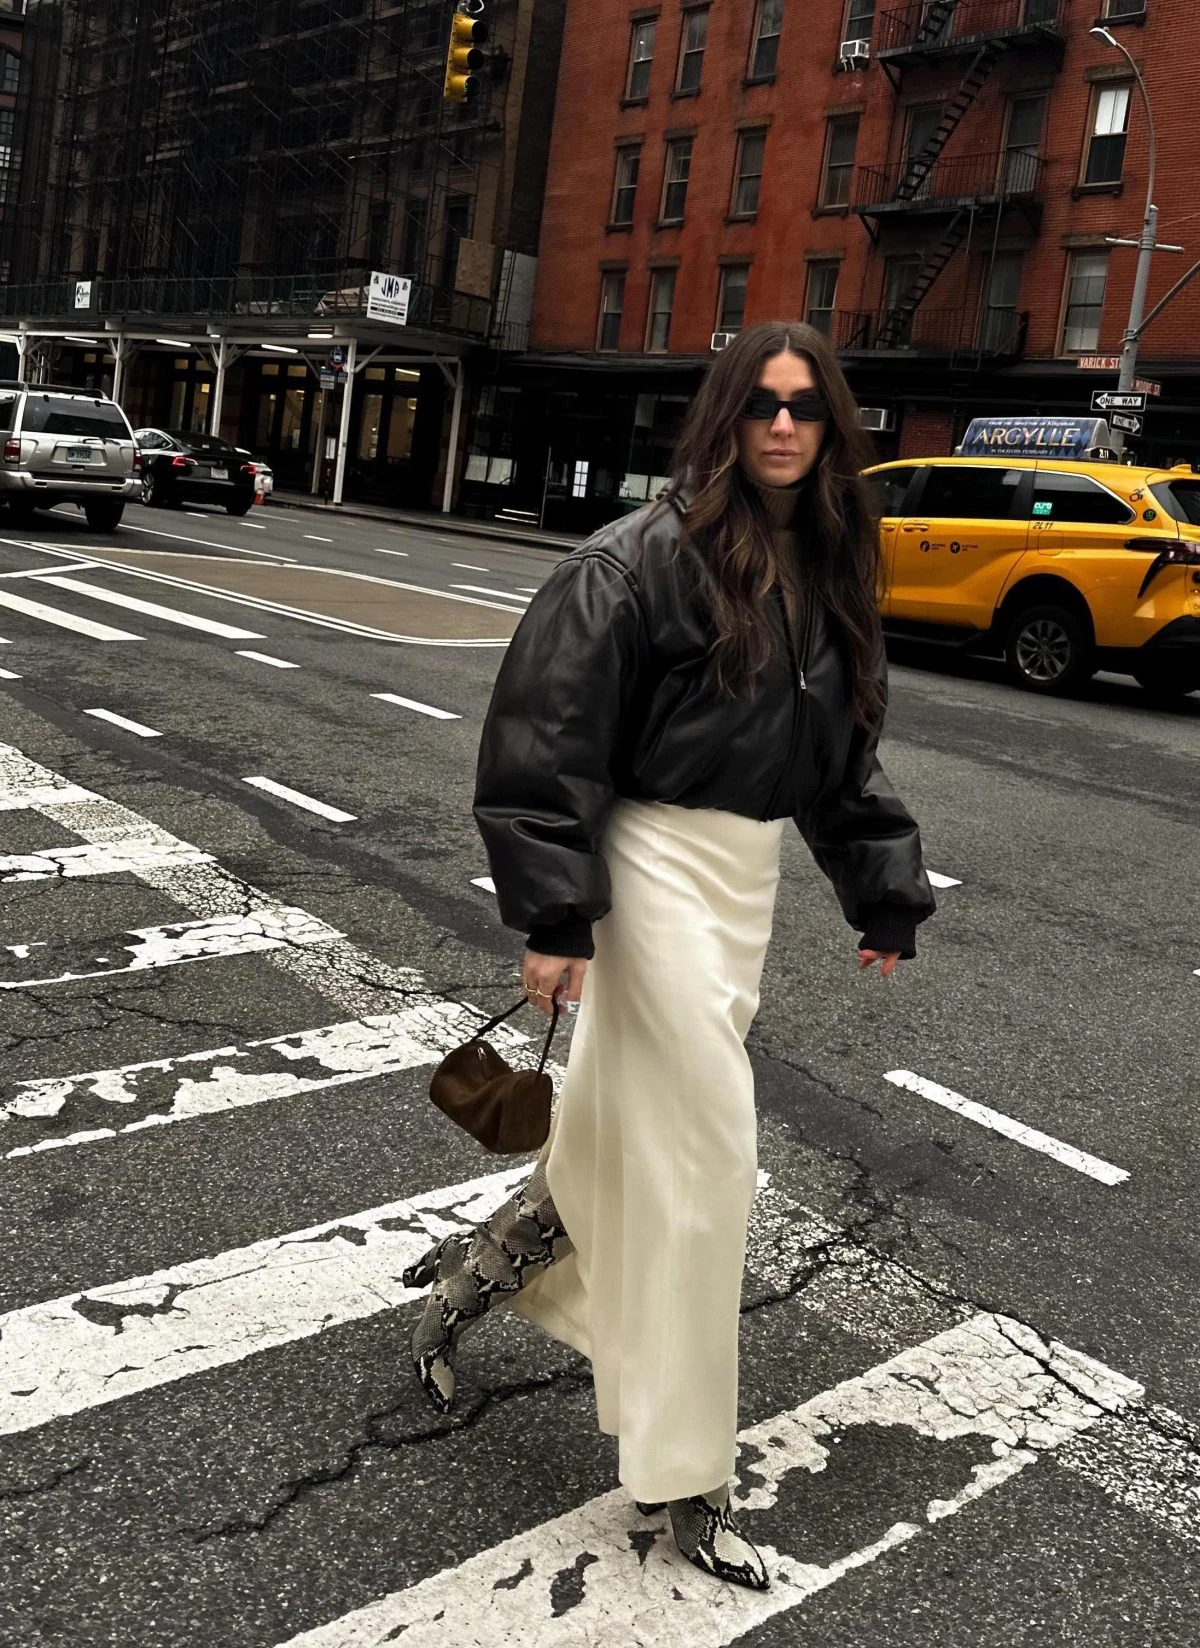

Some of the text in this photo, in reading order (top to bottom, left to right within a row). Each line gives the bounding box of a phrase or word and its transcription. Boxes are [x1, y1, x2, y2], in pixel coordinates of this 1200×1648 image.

[1080, 357, 1120, 369] VARICK ST
[1100, 397, 1138, 405] ONE WAY
[1115, 416, 1138, 428] ONE WAY
[972, 427, 1081, 446] ARGYLLE
[1032, 521, 1054, 530] 2L11
